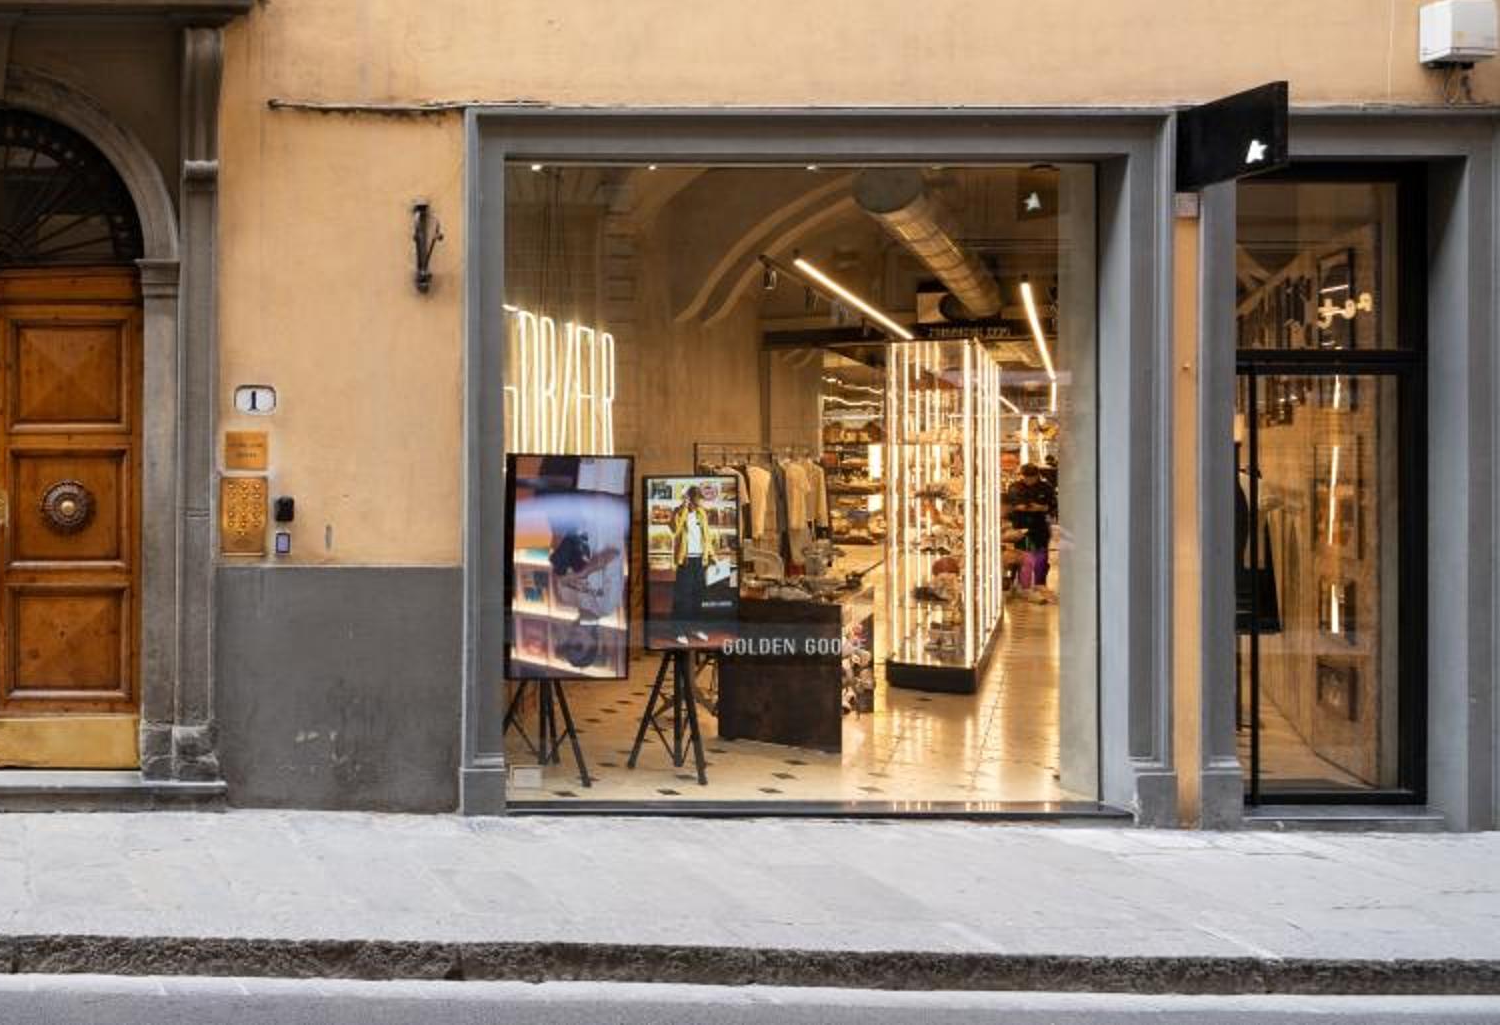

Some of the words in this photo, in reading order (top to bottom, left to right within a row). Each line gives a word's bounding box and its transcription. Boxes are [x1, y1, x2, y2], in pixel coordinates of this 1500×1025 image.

[248, 390, 260, 412] 1
[723, 638, 796, 656] GOLDEN
[805, 638, 868, 656] GOOE
